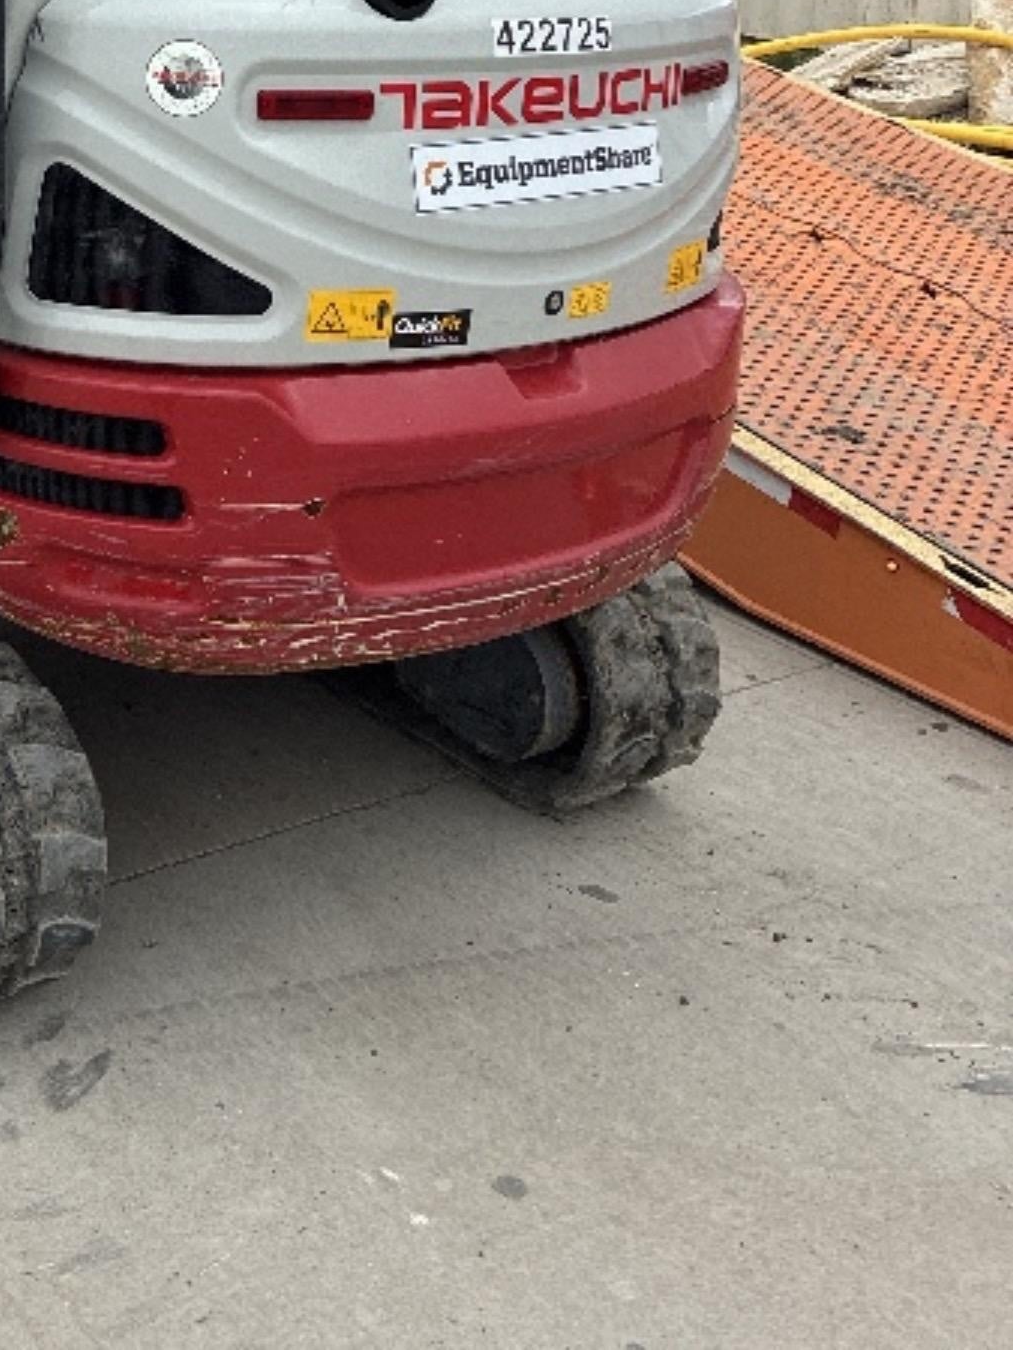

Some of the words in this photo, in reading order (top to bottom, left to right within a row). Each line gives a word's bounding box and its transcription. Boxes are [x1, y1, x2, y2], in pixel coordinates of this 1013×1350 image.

[496, 17, 612, 54] 422725
[379, 62, 683, 130] TAKEUCHI
[457, 144, 653, 190] EquipmentShare
